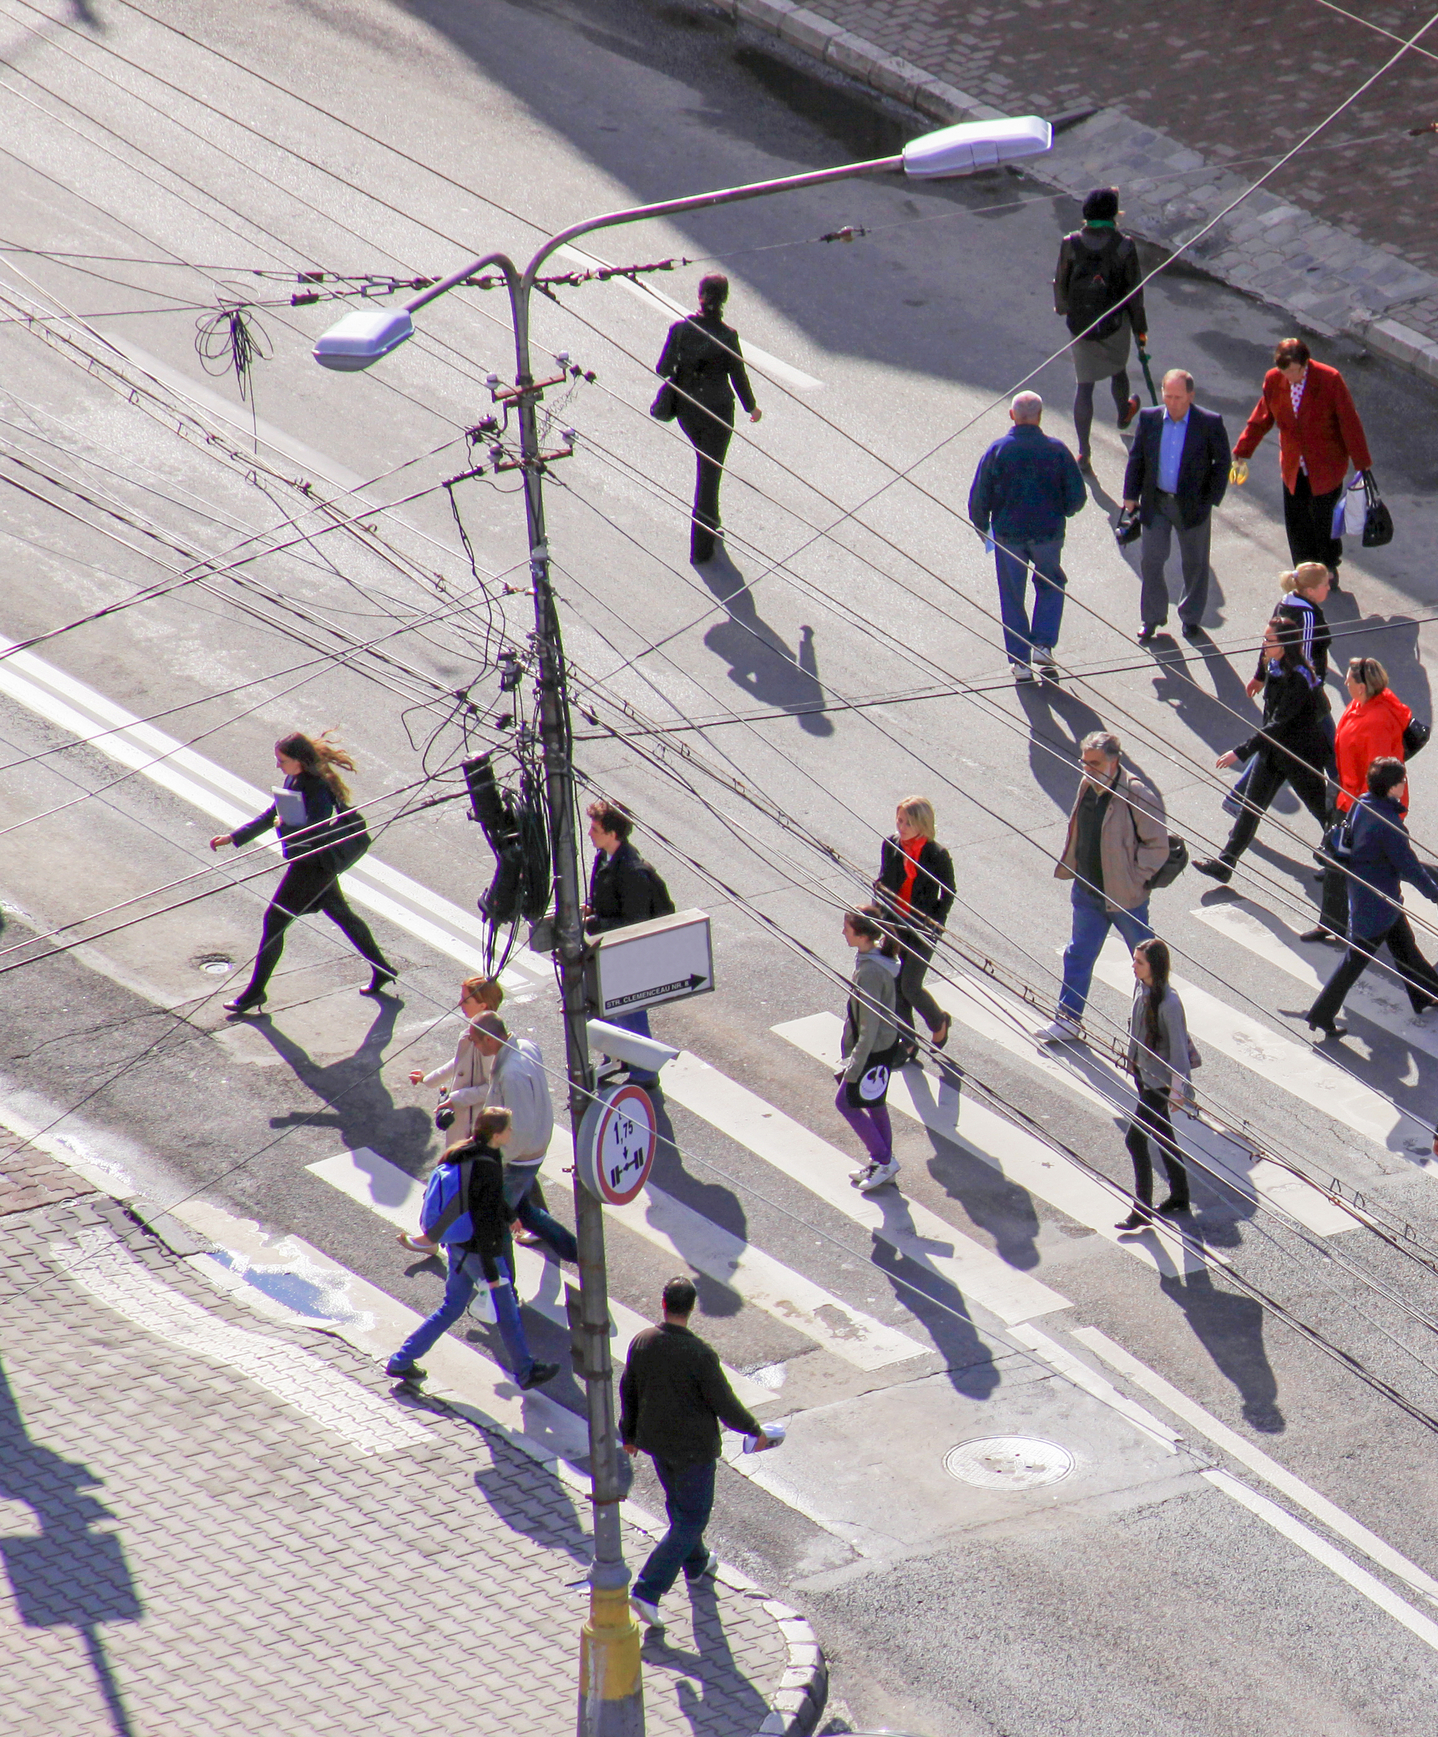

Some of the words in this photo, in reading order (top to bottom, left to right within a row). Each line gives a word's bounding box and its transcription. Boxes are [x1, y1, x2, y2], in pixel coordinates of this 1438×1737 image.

[605, 999, 621, 1009] STR.
[622, 985, 671, 1003] CLEMENCEAU
[613, 1120, 634, 1145] 1,75
